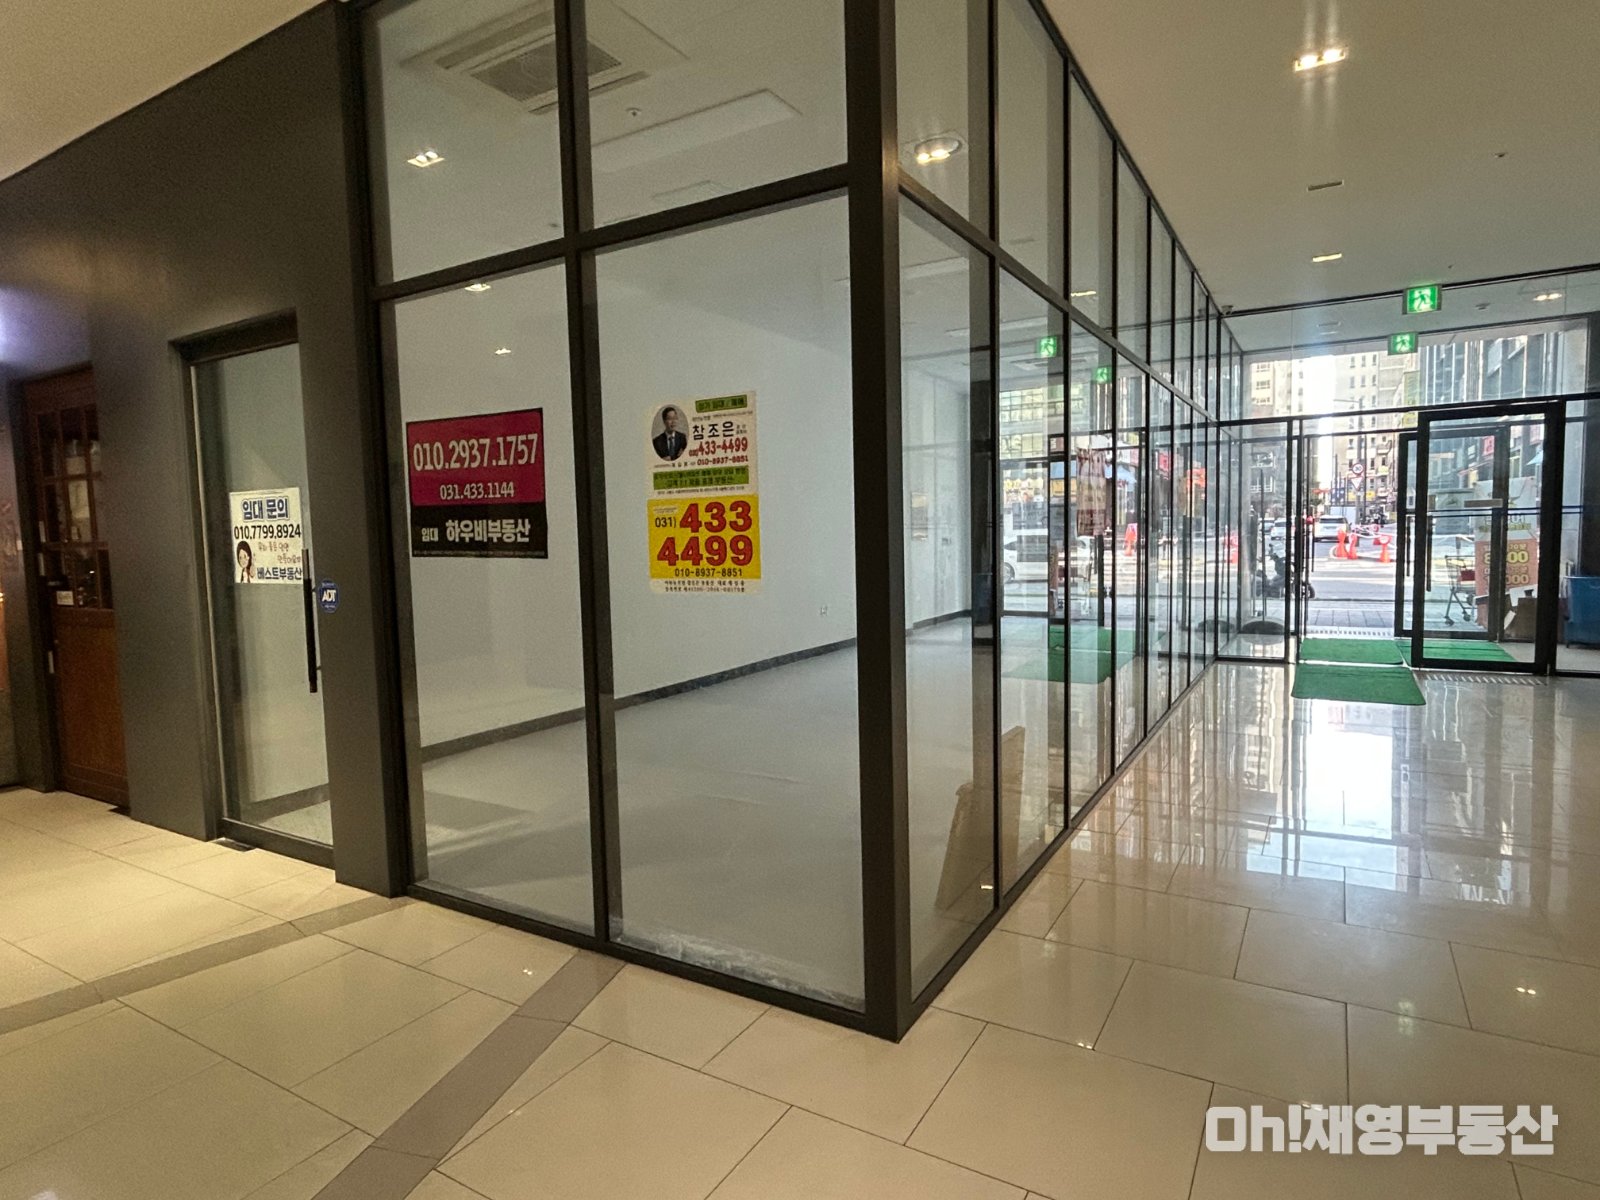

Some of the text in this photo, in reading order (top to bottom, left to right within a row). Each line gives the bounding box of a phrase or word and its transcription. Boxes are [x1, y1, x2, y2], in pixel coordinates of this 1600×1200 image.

[413, 433, 538, 471] 010.2937.1757
[440, 482, 515, 500] 031.433.1144
[243, 497, 289, 520] 임대 문의
[655, 500, 752, 533] 031) 433
[234, 523, 302, 539] 010.7799.8924
[421, 527, 438, 542] 임대
[657, 534, 753, 566] 4499
[256, 567, 302, 580] 베스트부동산
[675, 568, 742, 577] 010-8937-8851
[321, 589, 337, 602] ADT
